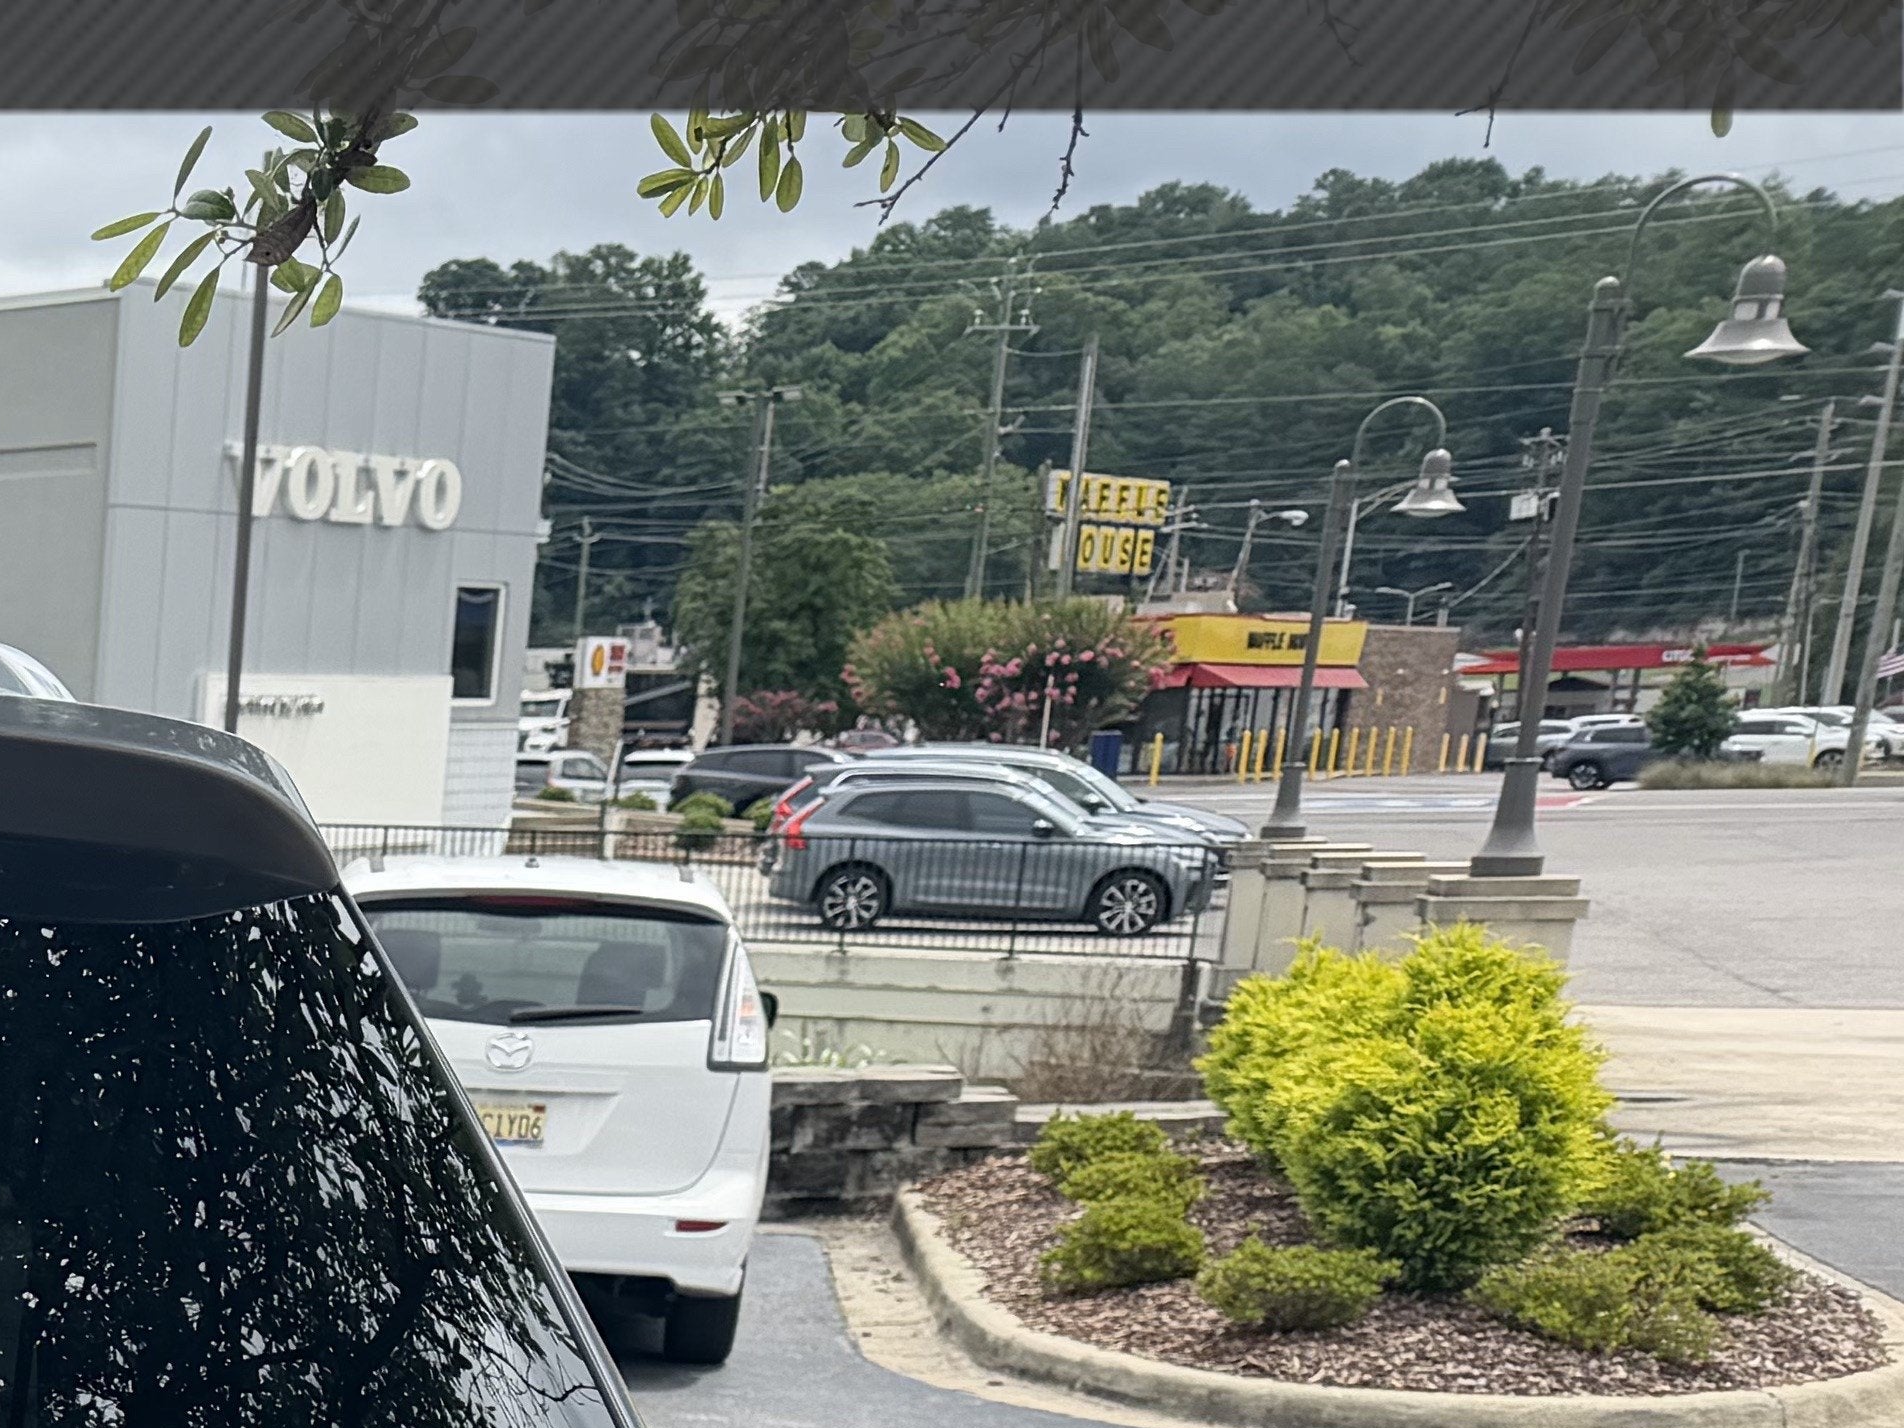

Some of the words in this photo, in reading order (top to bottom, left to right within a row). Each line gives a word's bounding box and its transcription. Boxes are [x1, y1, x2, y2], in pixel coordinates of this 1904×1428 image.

[223, 438, 462, 530] VOLVO
[1057, 477, 1170, 519] AFFLE
[1080, 532, 1154, 568] OUSE
